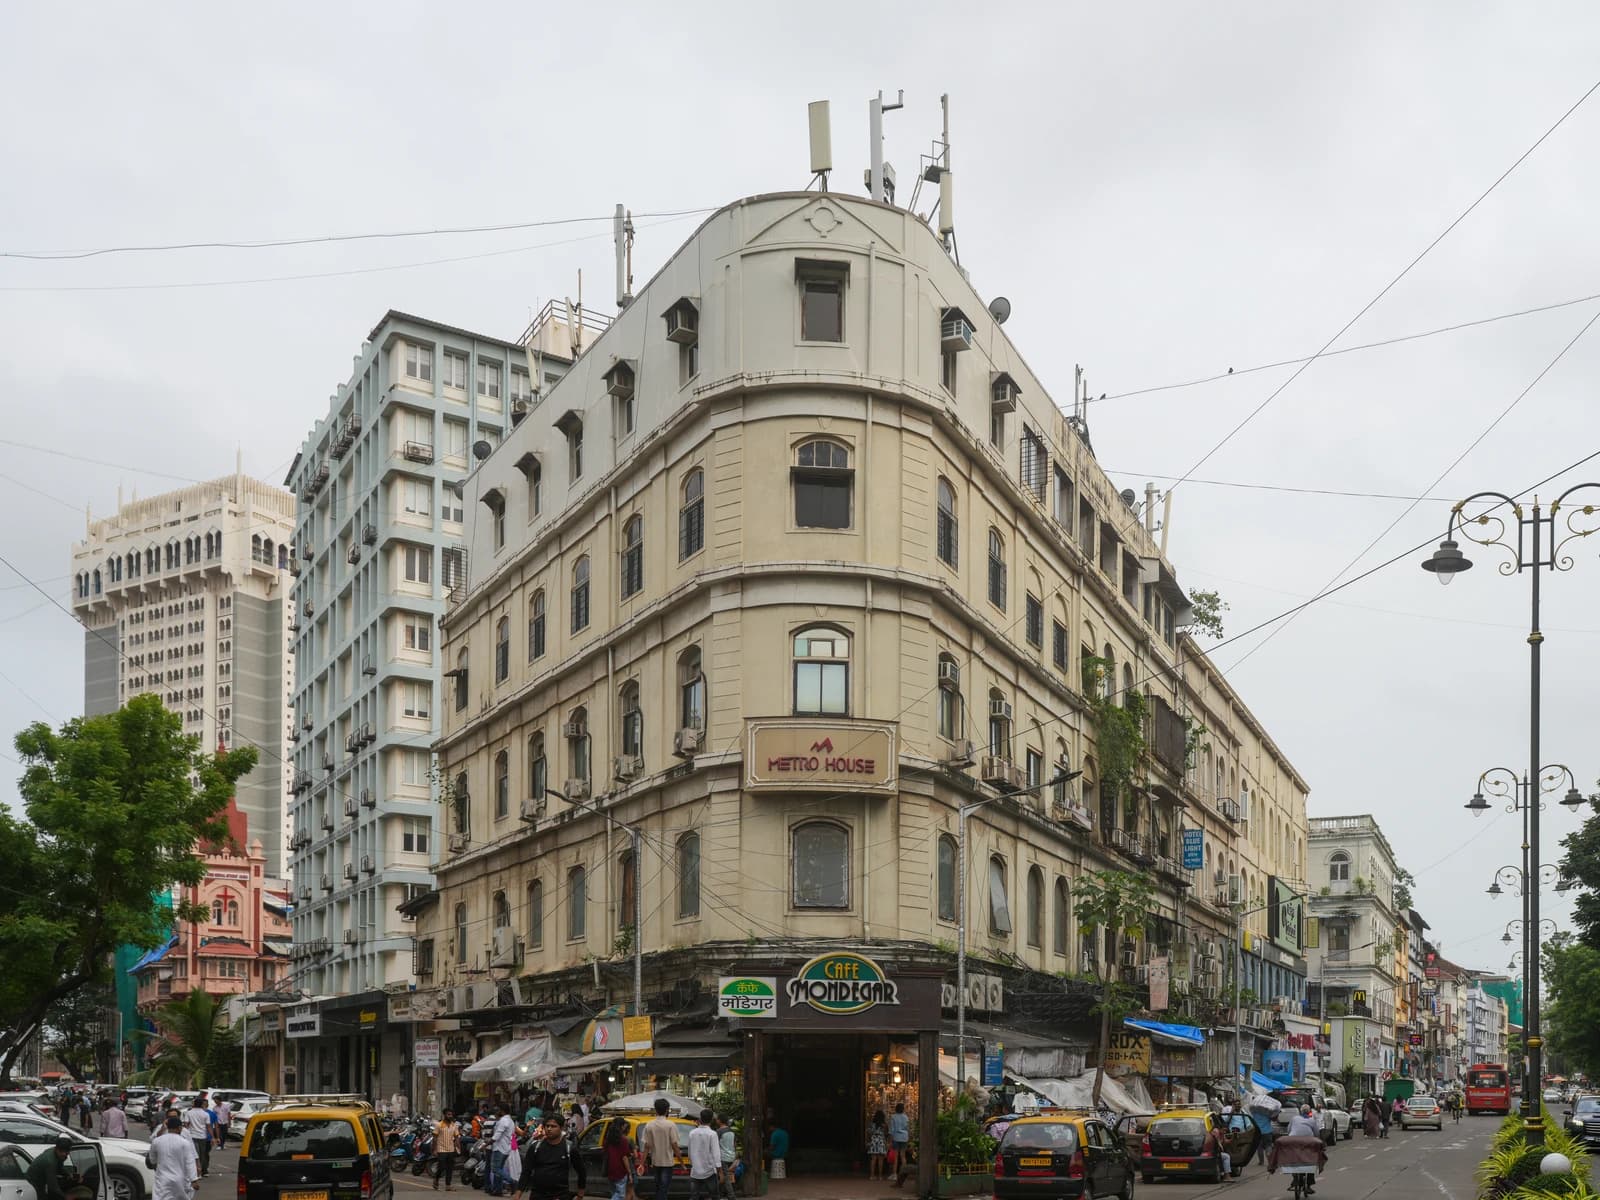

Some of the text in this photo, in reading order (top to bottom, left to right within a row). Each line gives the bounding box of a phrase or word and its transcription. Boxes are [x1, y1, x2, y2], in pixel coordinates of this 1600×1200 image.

[768, 757, 875, 774] METRO HOUSE
[825, 960, 859, 979] CAFE
[790, 980, 896, 1002] MONDEGAR
